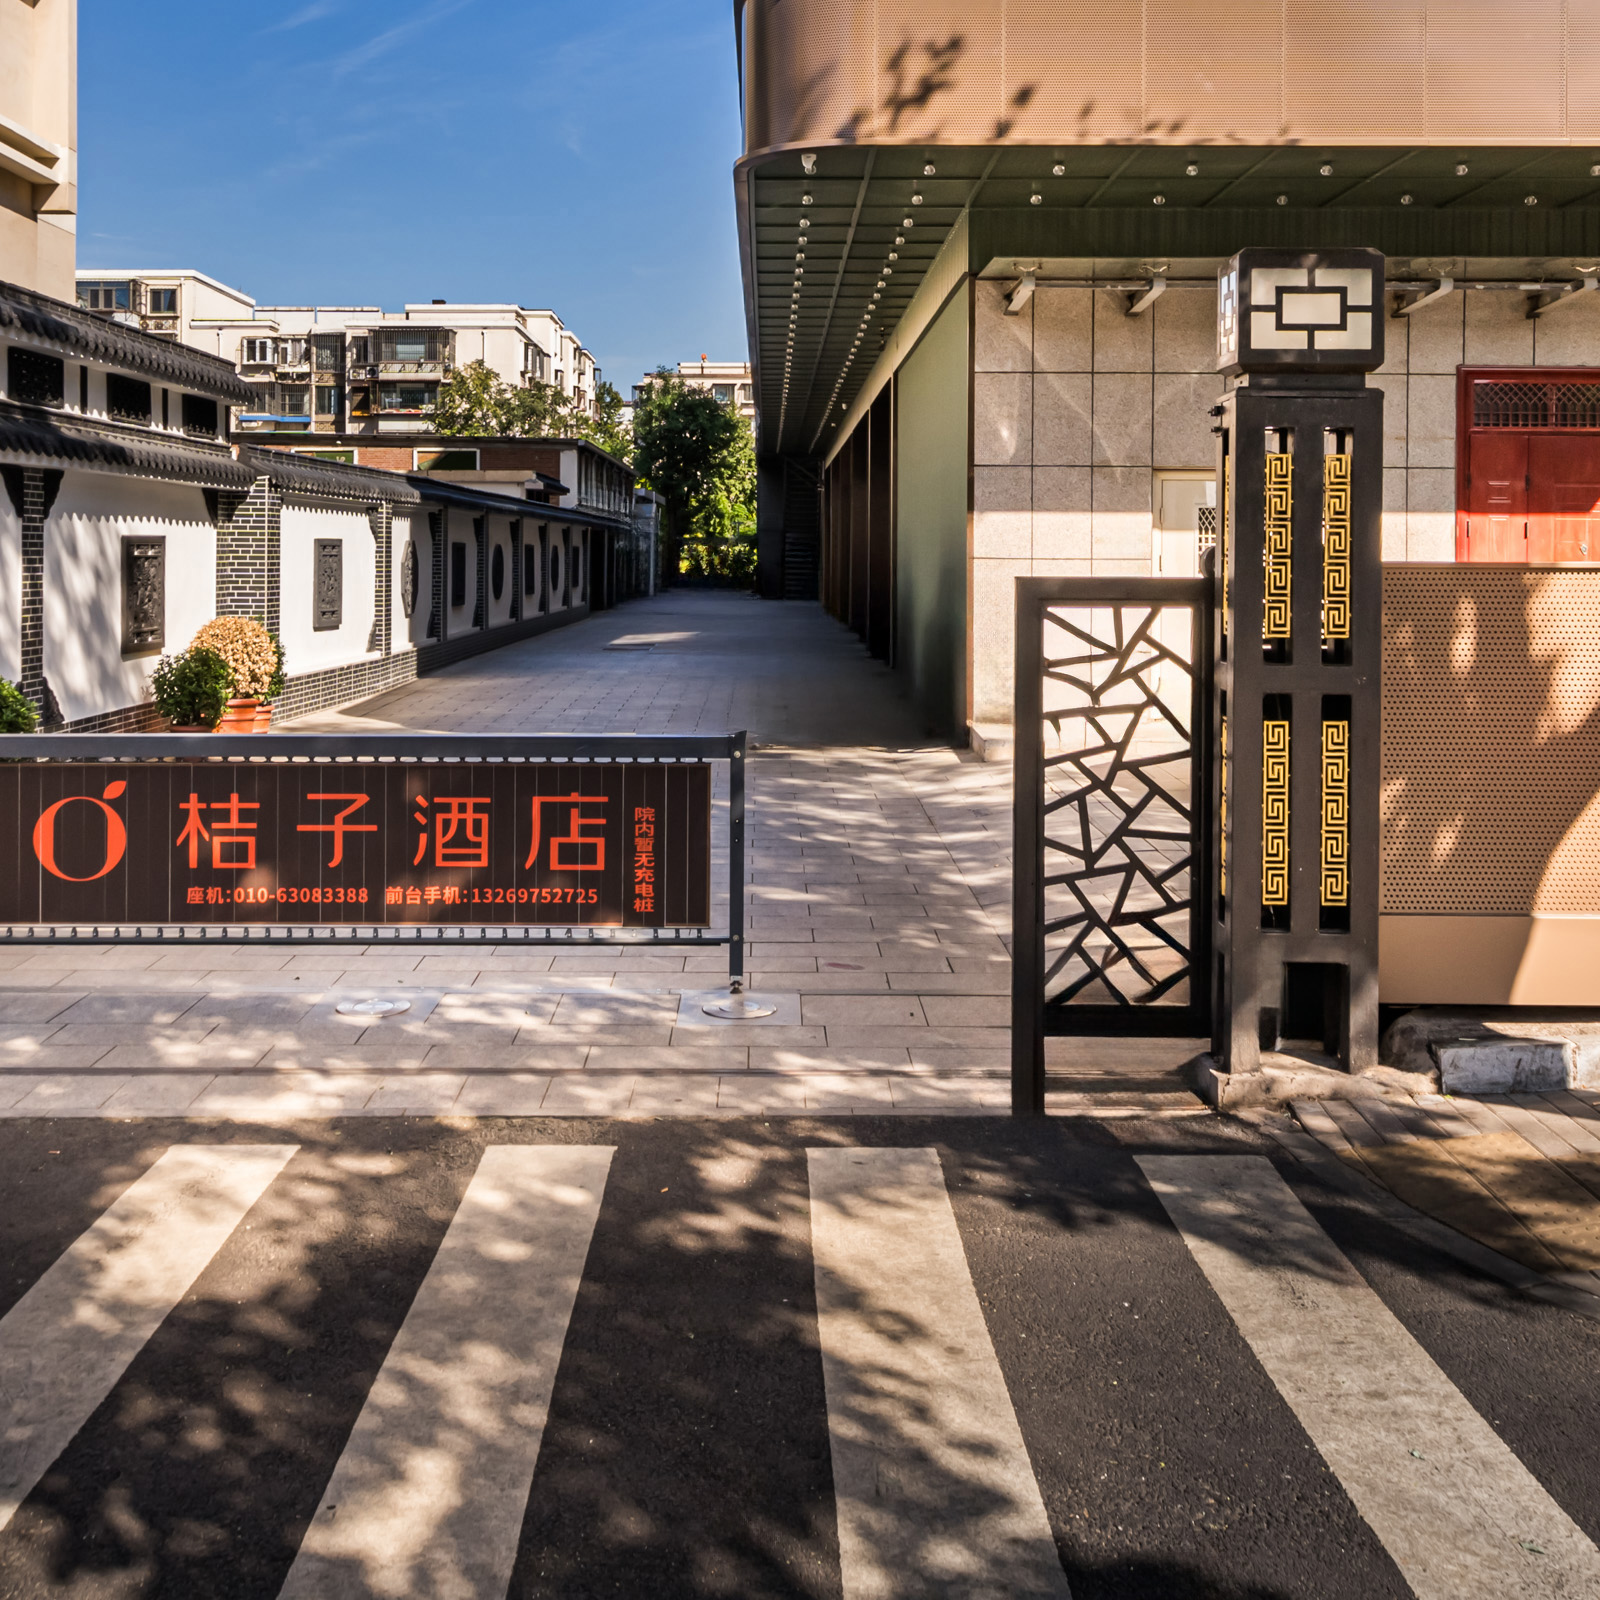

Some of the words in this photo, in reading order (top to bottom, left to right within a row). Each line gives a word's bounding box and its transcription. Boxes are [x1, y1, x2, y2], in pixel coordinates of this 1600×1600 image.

[177, 793, 610, 872] 桔子酒店
[634, 806, 656, 913] 院内暂无充电桩
